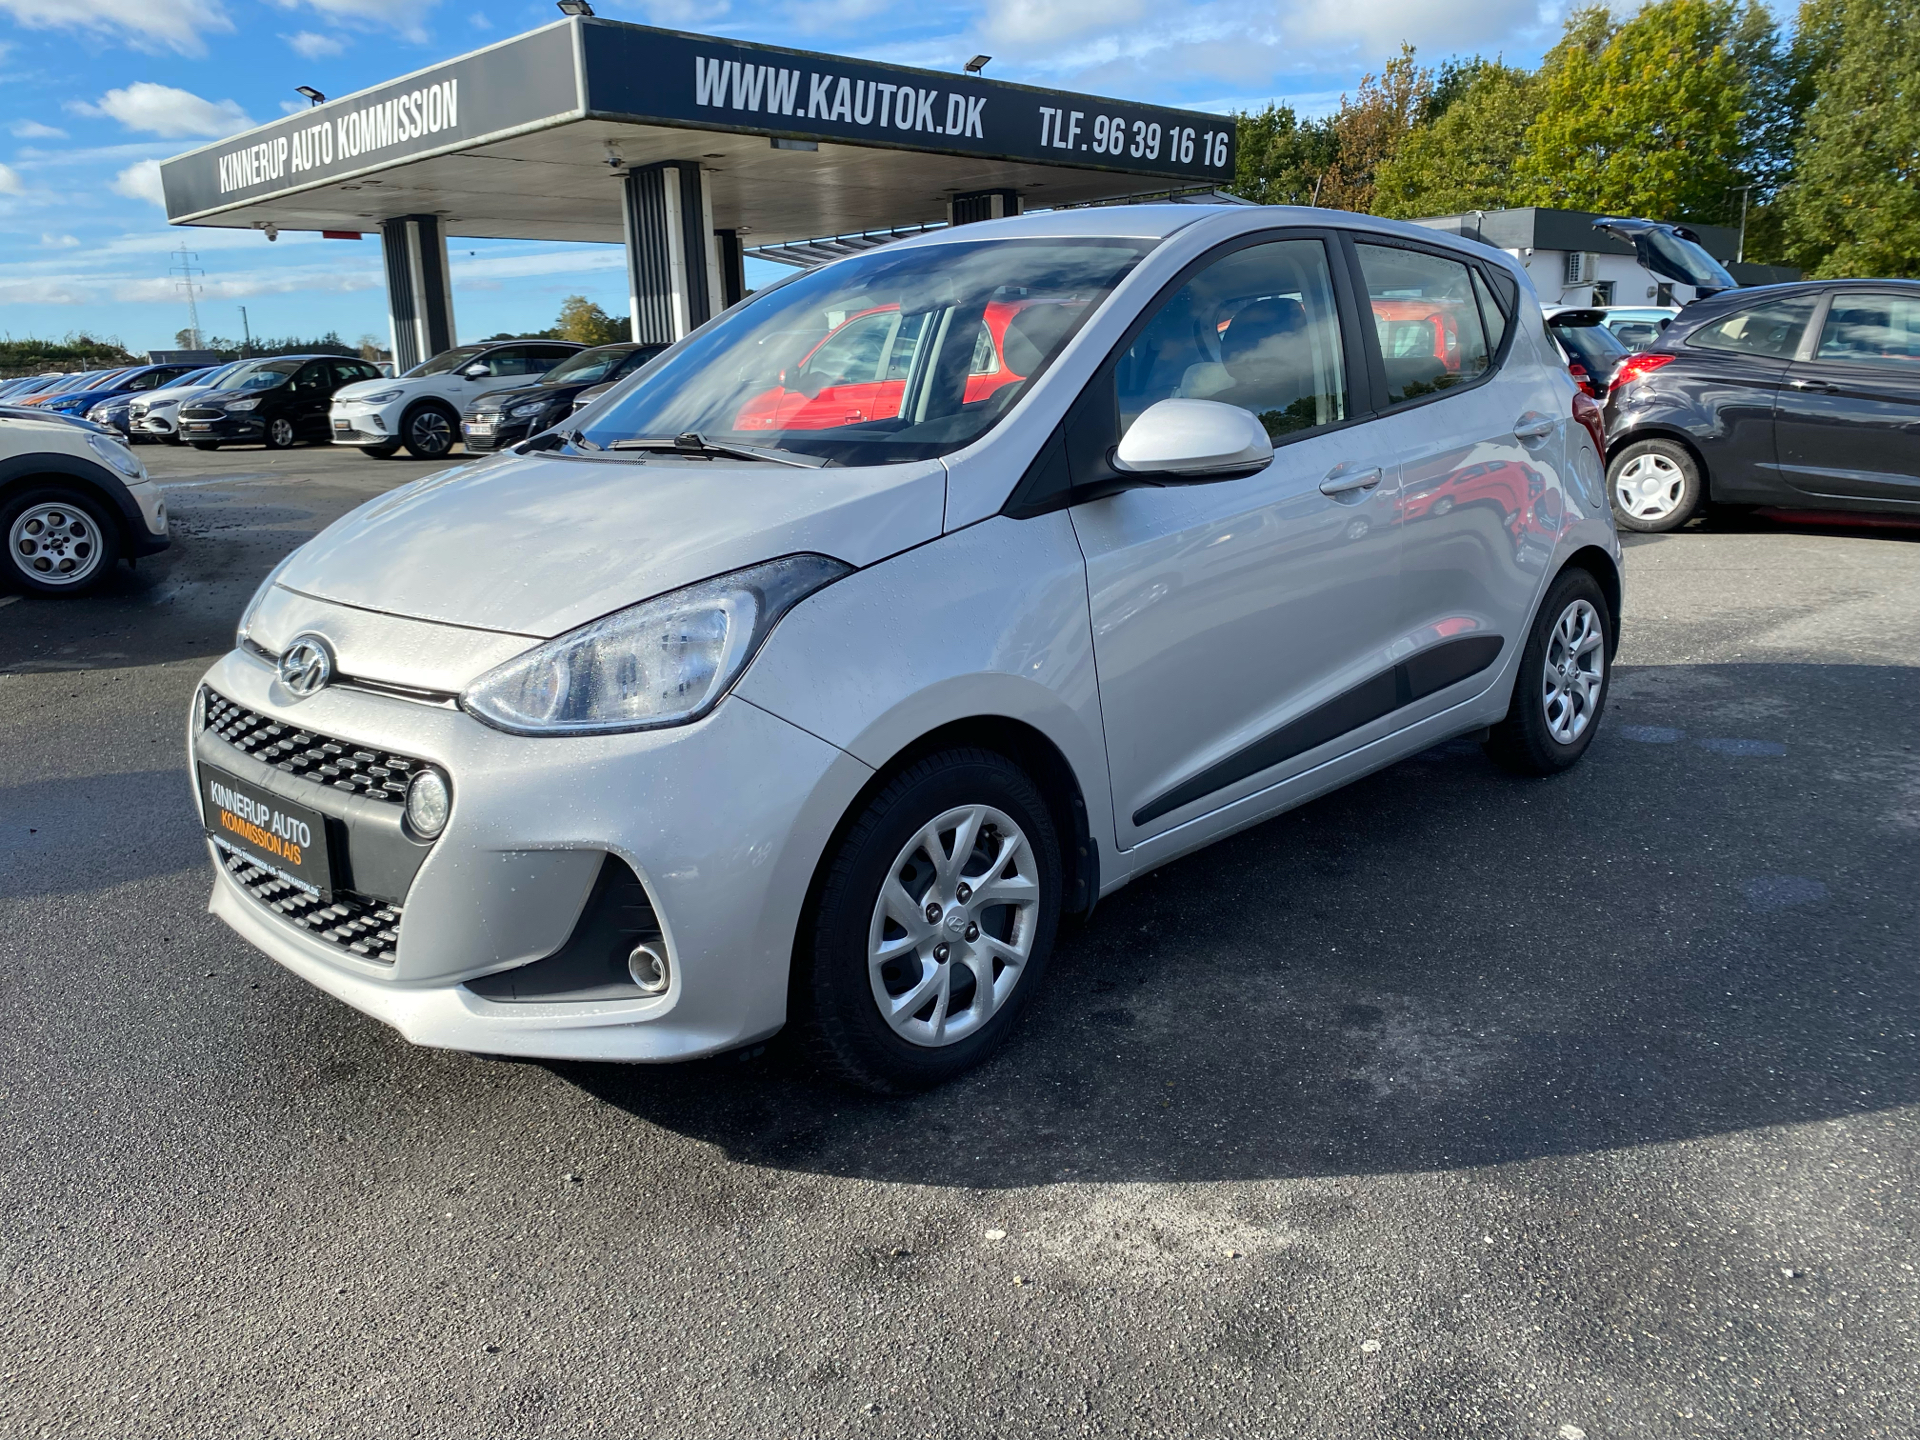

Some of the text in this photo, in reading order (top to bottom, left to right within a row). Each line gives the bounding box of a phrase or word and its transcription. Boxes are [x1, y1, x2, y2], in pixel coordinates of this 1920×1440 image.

[695, 56, 987, 139] WWW.KAUTOK.DK
[218, 78, 458, 194] KINNERUP AUTO KOMMISSION
[1130, 120, 1161, 160] 39
[1169, 126, 1196, 164] 16
[1203, 130, 1229, 168] 16
[211, 780, 311, 848] KINNERUP AUTO
[221, 809, 281, 856] KOMMISSION
[283, 841, 302, 866] A/S
